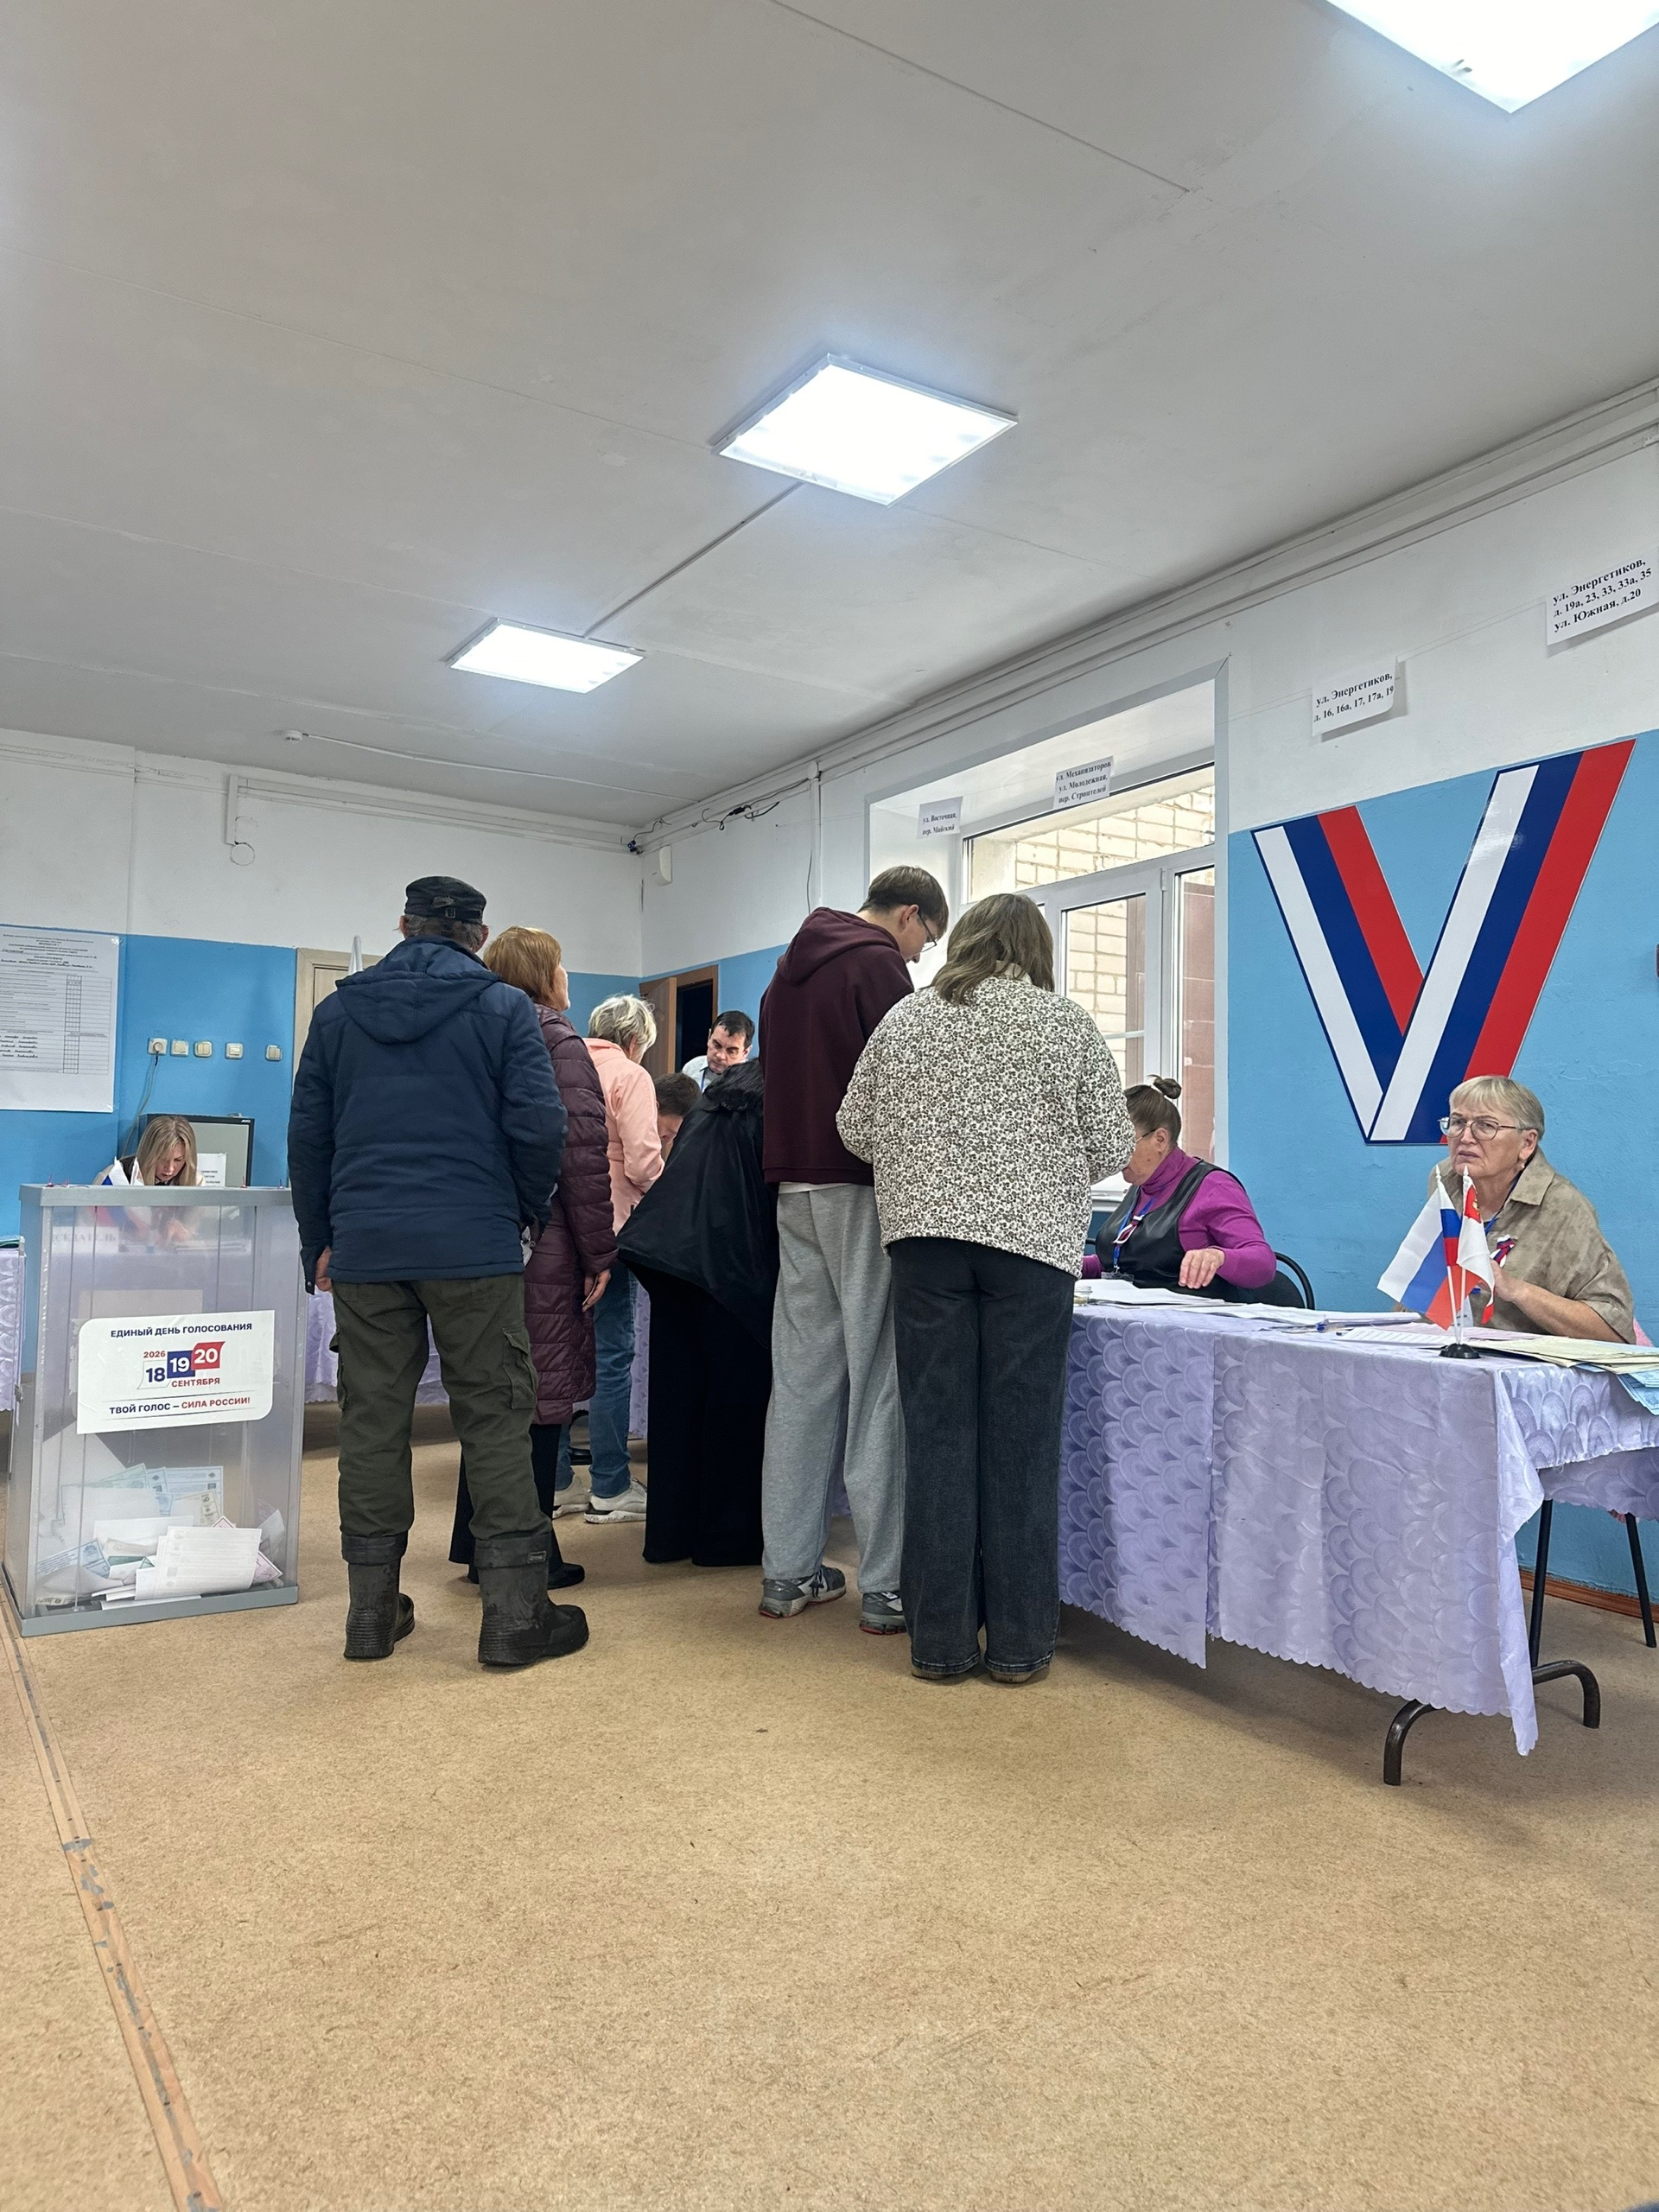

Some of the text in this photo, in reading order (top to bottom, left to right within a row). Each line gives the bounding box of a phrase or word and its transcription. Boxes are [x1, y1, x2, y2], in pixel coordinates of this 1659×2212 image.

[1553, 559, 1646, 606] ул. Энергетиков,
[1554, 568, 1652, 618] д. 19а, 23, 33, 33а, 35
[1554, 588, 1642, 632] ул. Южная, д.20
[1316, 673, 1393, 708] ул. Энергетиков,
[1323, 709, 1334, 718] 16,
[1337, 703, 1352, 714] 16а,
[1354, 697, 1365, 708] 17,
[1368, 692, 1384, 702] 17а,
[1386, 685, 1394, 696] 19
[111, 1323, 252, 1338] ЕДИНЫЙ ДЕНЬ ГОЛОСОВАНИЯ
[145, 1348, 218, 1382] 18 19 20
[171, 1377, 220, 1388] СЕНТЯБРЯ
[109, 1402, 137, 1414] ТВОЙ
[138, 1403, 171, 1413] ГОЛОС
[181, 1401, 207, 1409] СИЛА
[210, 1397, 251, 1408] РОССИИ!
